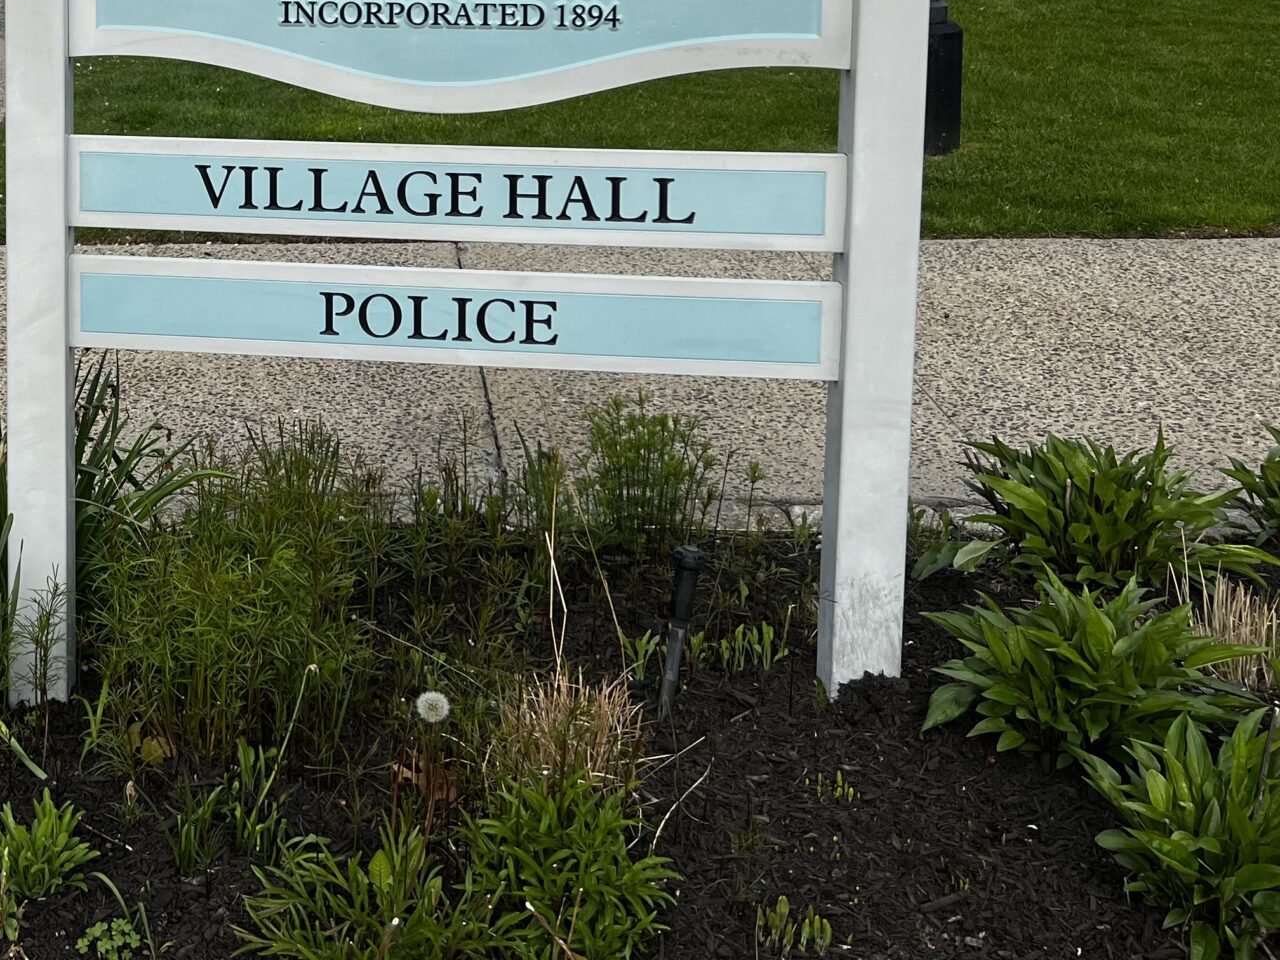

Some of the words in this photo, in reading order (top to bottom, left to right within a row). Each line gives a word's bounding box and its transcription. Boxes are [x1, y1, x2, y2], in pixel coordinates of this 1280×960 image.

[280, 0, 545, 27] INCORPORATED
[554, 4, 621, 29] 1894
[195, 164, 484, 218] VILLAGE
[502, 174, 697, 224] HALL
[319, 291, 559, 346] POLICE
